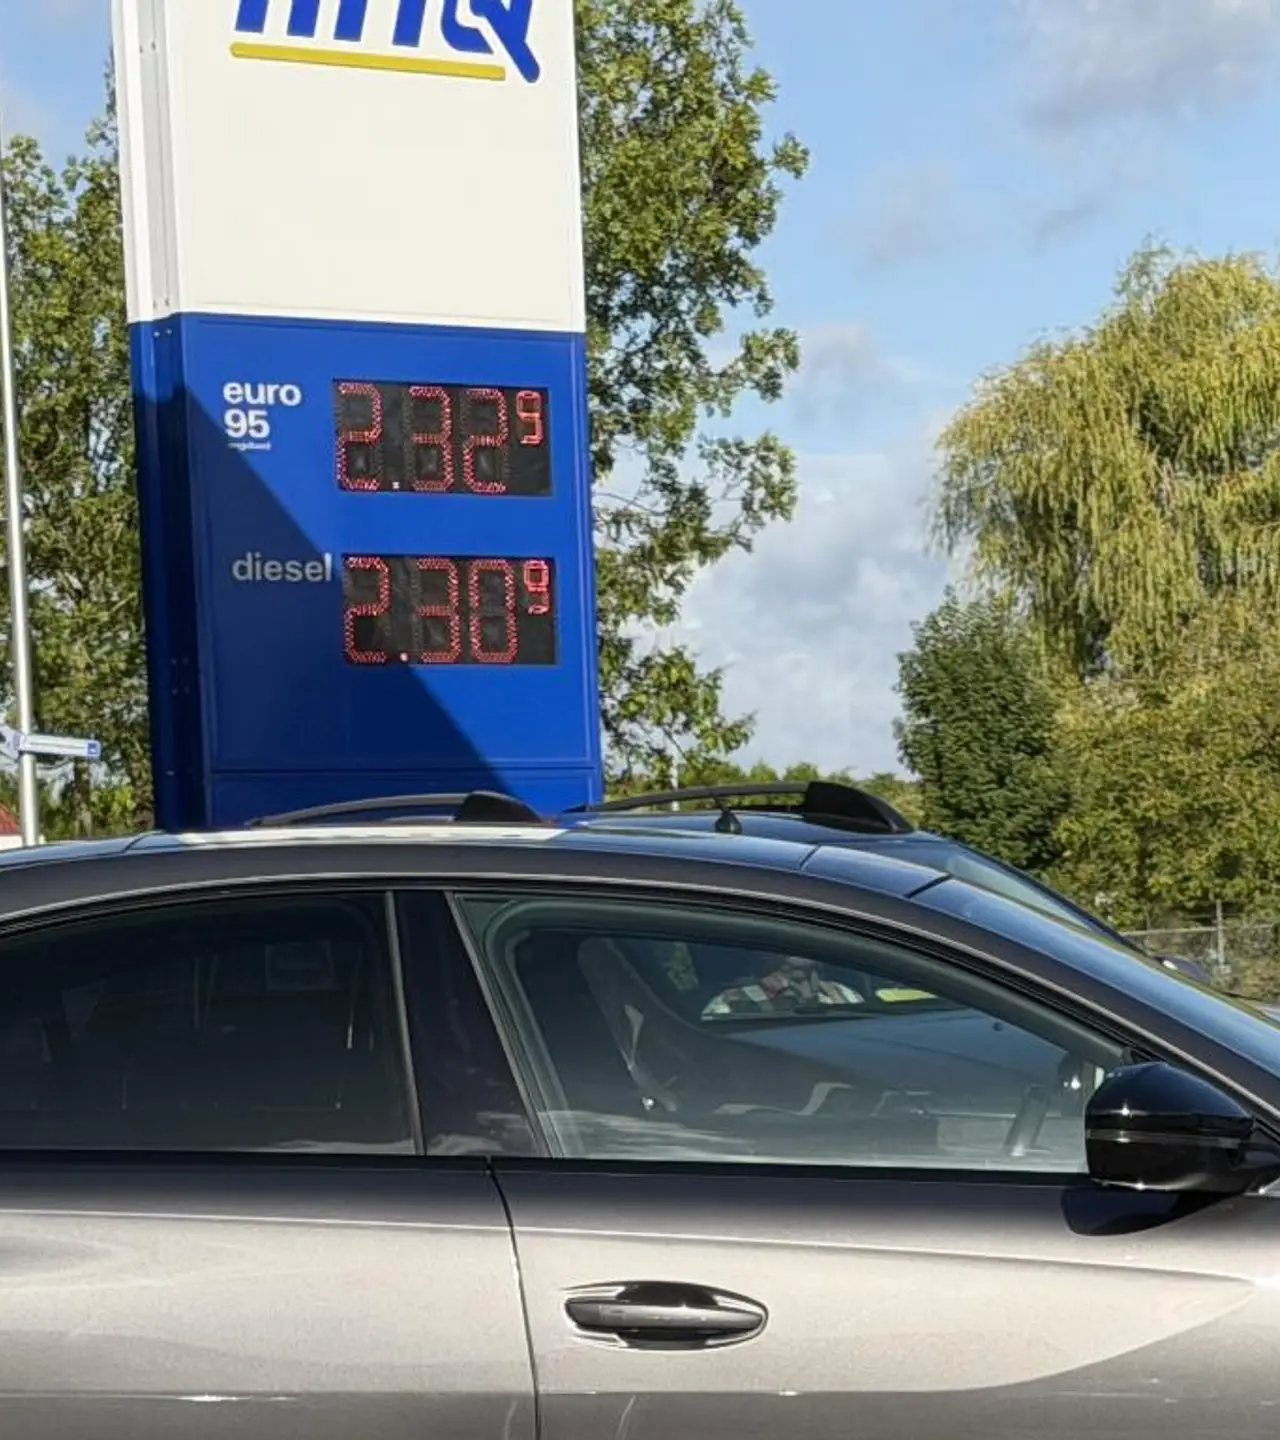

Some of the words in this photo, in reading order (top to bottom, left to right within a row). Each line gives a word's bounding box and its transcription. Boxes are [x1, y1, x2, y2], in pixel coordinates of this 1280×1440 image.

[223, 381, 302, 406] euro
[223, 409, 270, 439] 95
[232, 552, 332, 582] diesel
